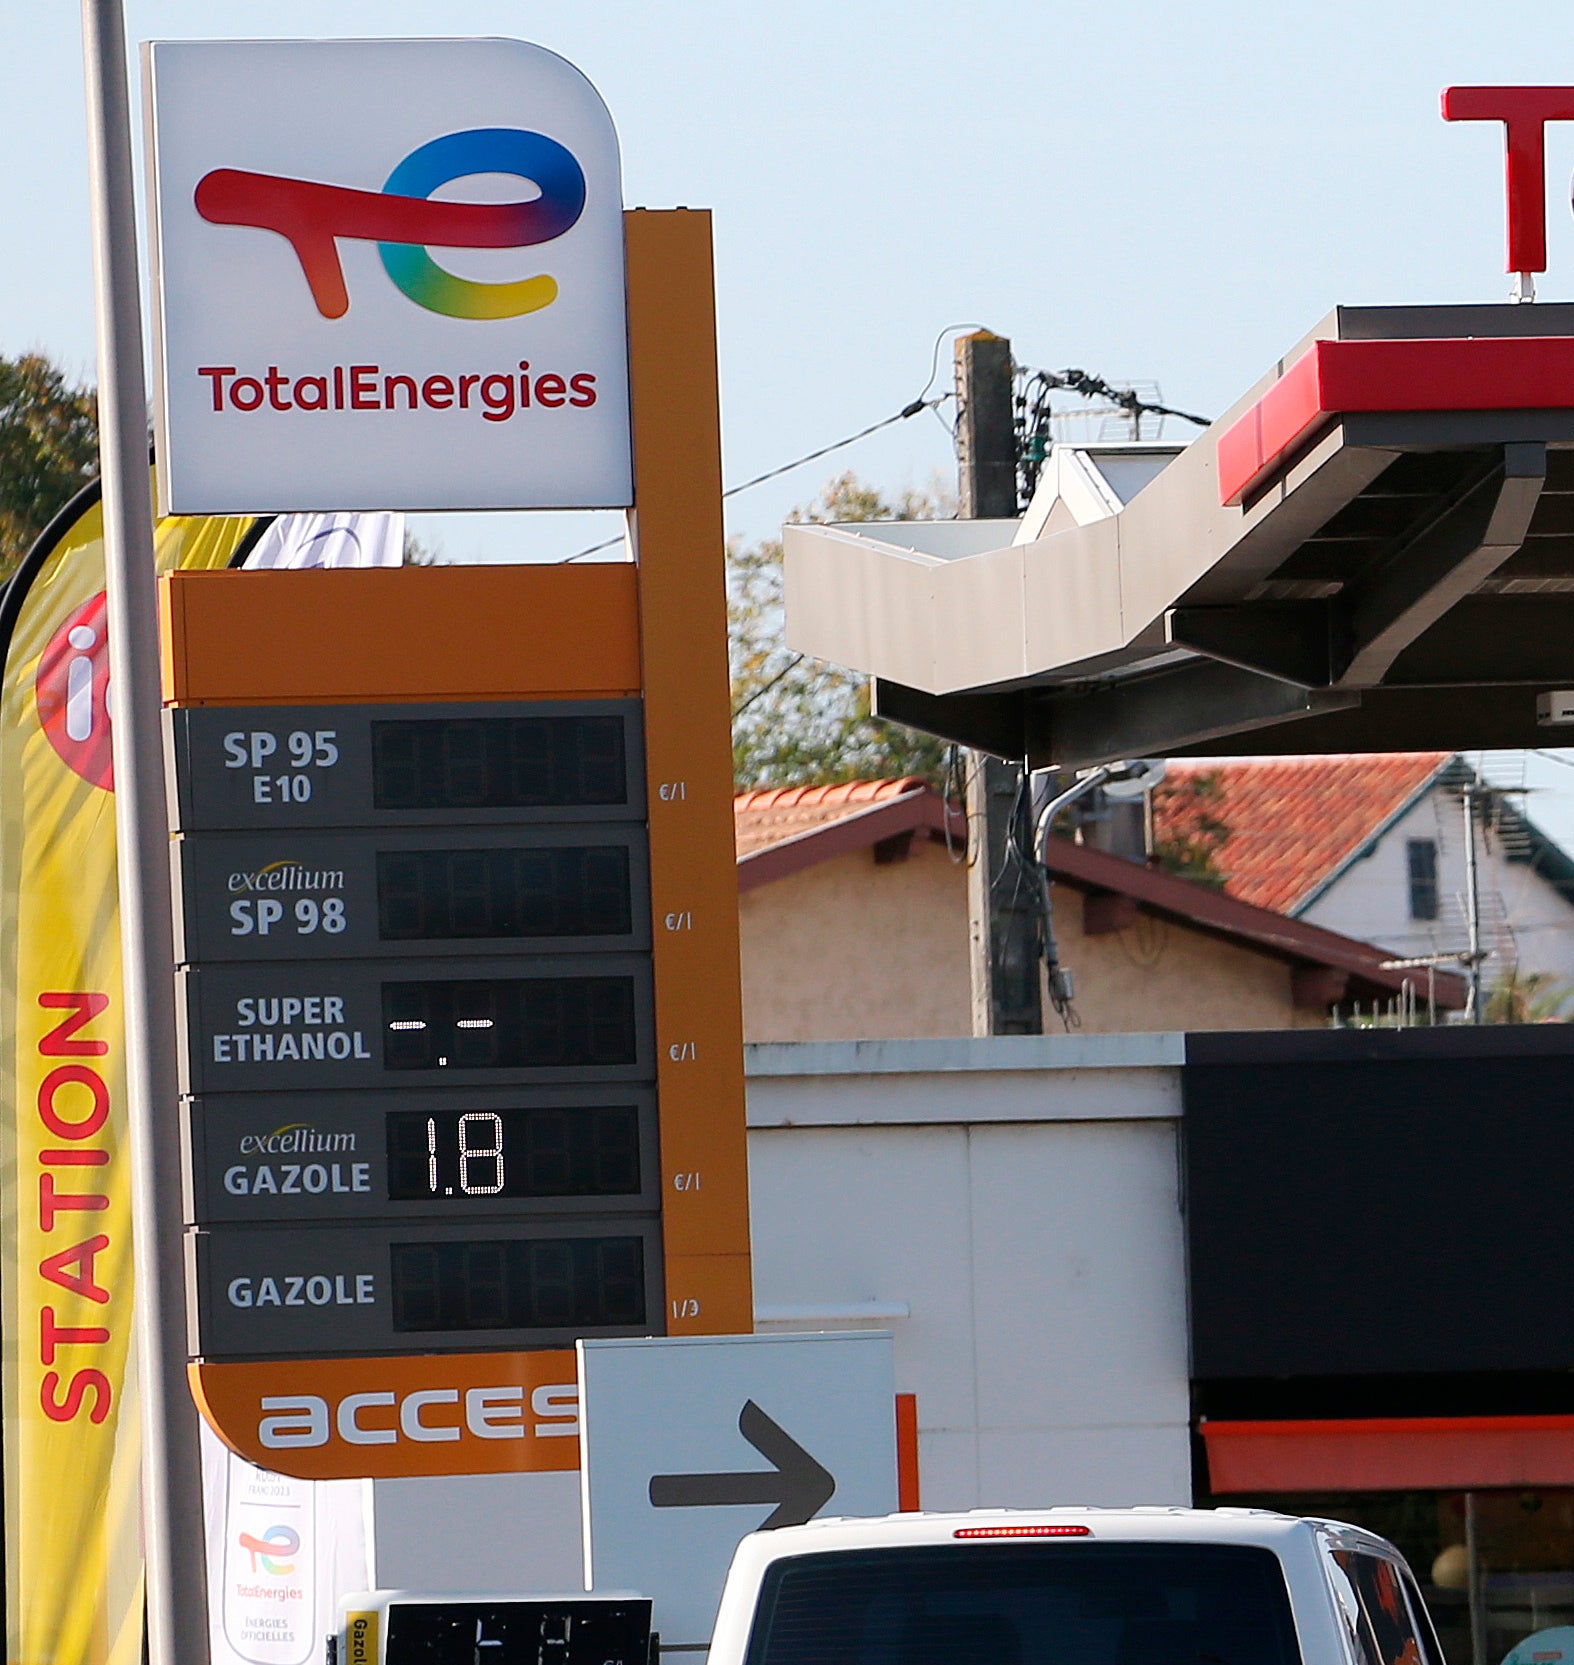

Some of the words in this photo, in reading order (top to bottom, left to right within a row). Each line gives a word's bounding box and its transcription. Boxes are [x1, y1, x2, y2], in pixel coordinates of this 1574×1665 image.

[199, 361, 597, 423] TotalEnergies
[223, 732, 277, 769] SP
[288, 730, 340, 768] 95
[228, 861, 345, 893] excellium
[230, 903, 286, 936] SP
[294, 900, 348, 936] 98
[237, 997, 345, 1027] SUPER
[212, 1030, 372, 1063] ETHANOL
[240, 1124, 357, 1156] excellium
[223, 1162, 371, 1197] GAZOLE
[38, 992, 111, 1425] STATION
[227, 1275, 376, 1309] GAZOLE
[237, 1583, 303, 1602] TotalEnergies
